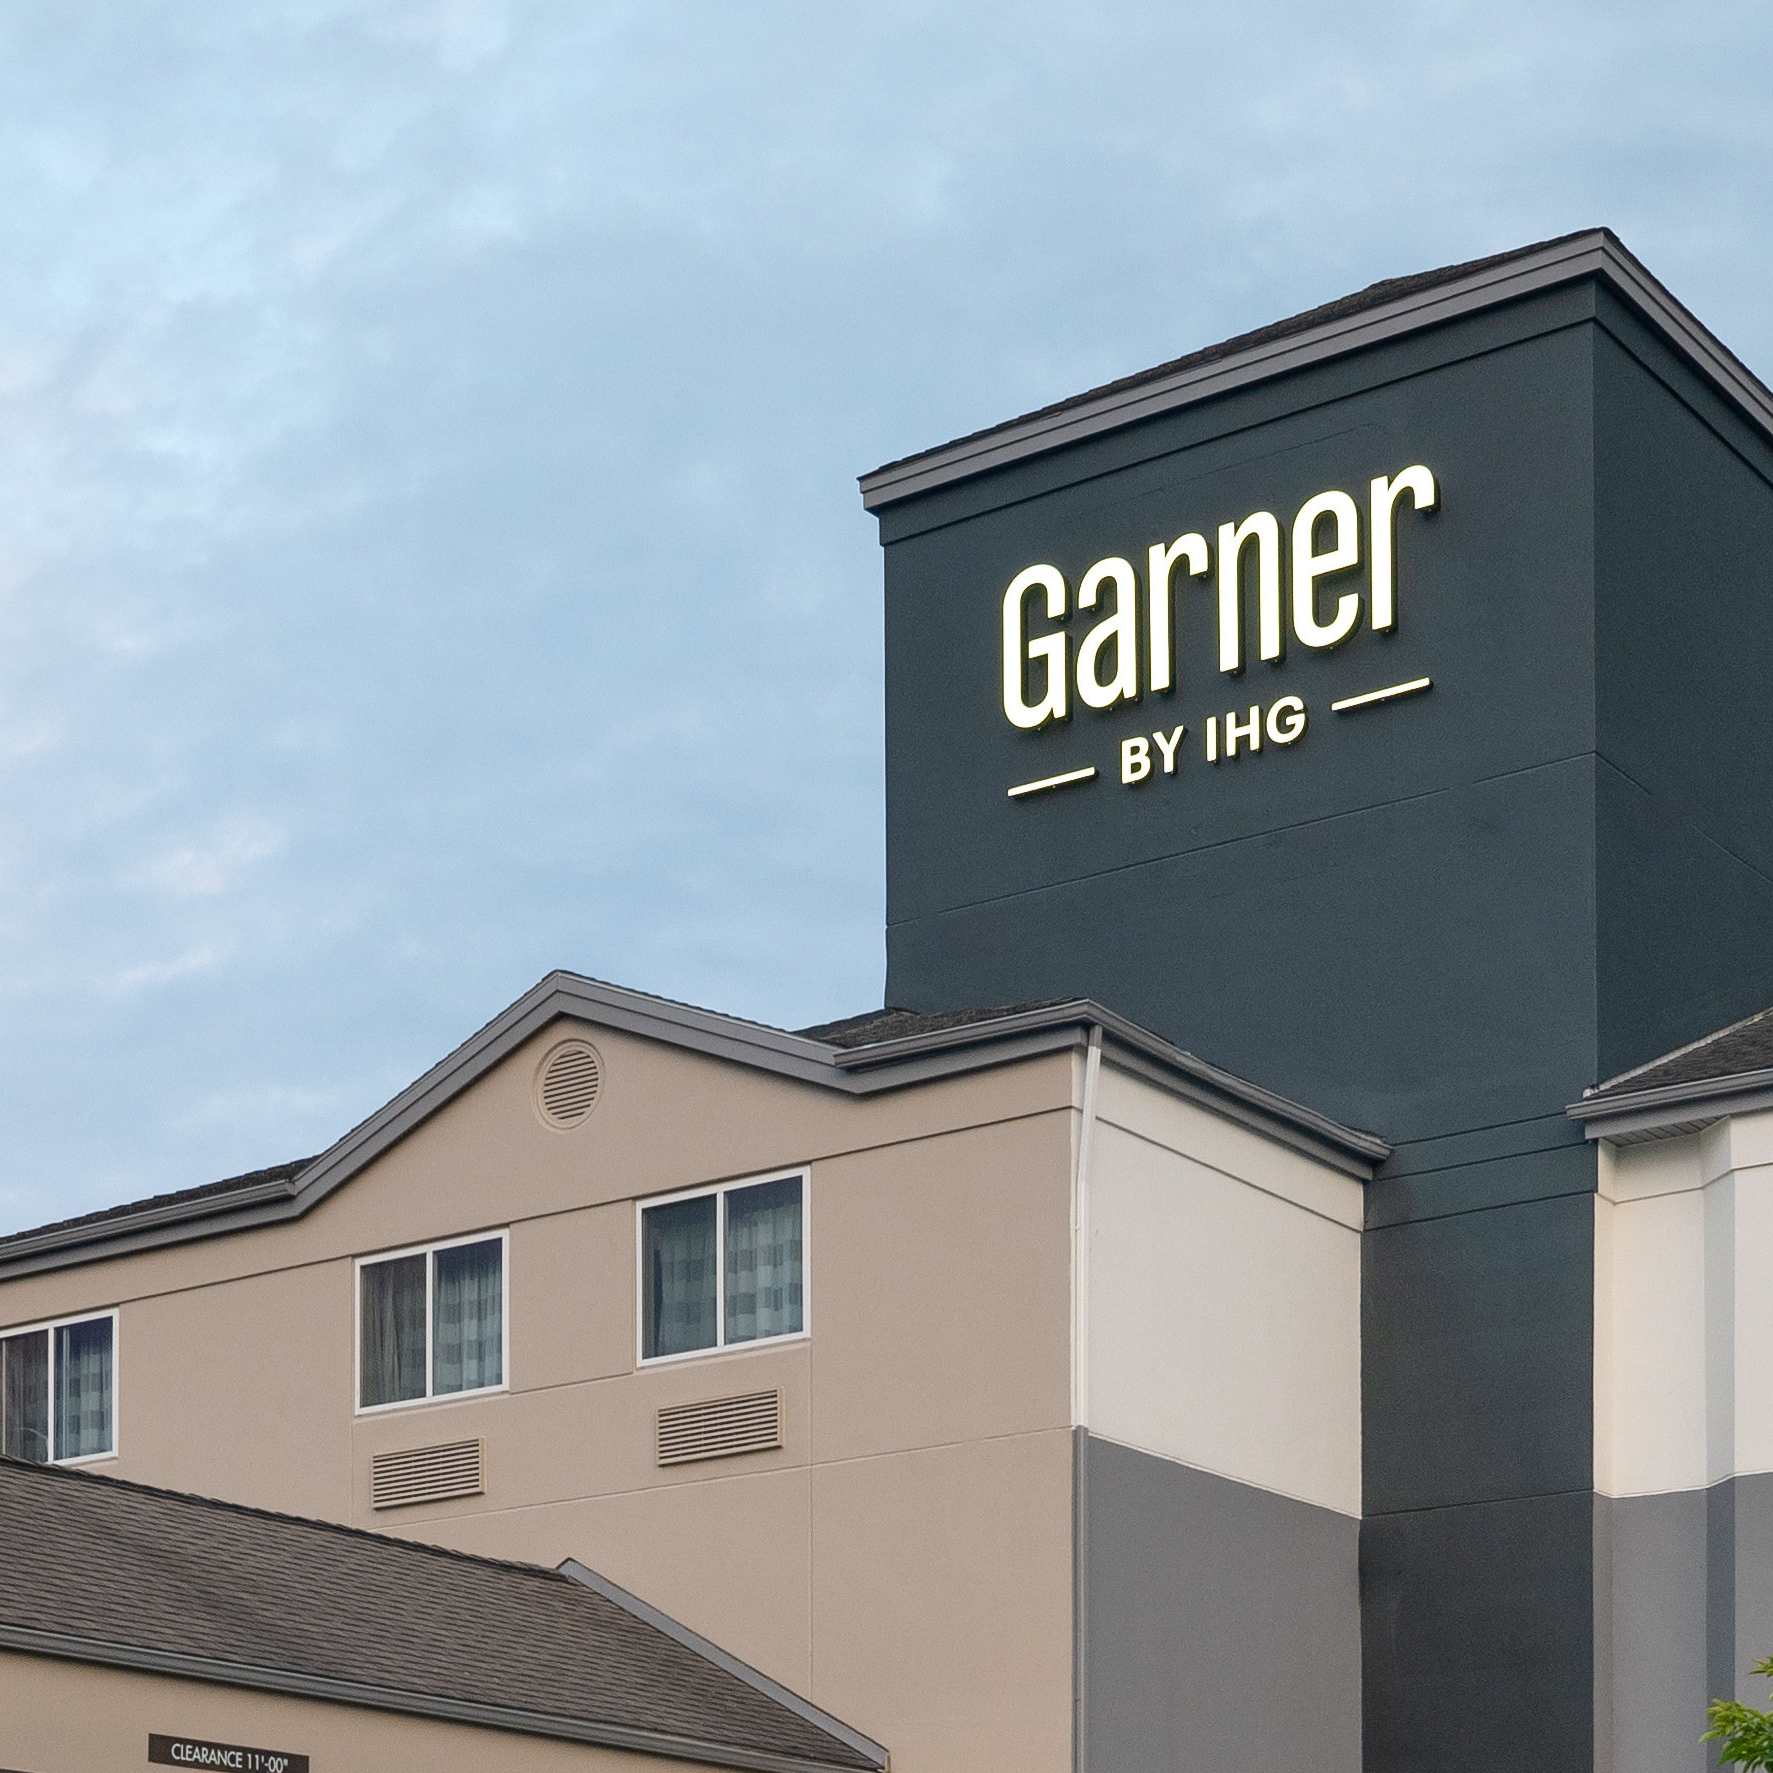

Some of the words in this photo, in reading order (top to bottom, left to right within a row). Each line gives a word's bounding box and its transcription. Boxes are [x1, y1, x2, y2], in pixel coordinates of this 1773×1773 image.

[1003, 464, 1435, 728] Garner
[1122, 725, 1186, 784] BY
[1206, 696, 1306, 763] IHG
[171, 1743, 243, 1768] CLEARANCE
